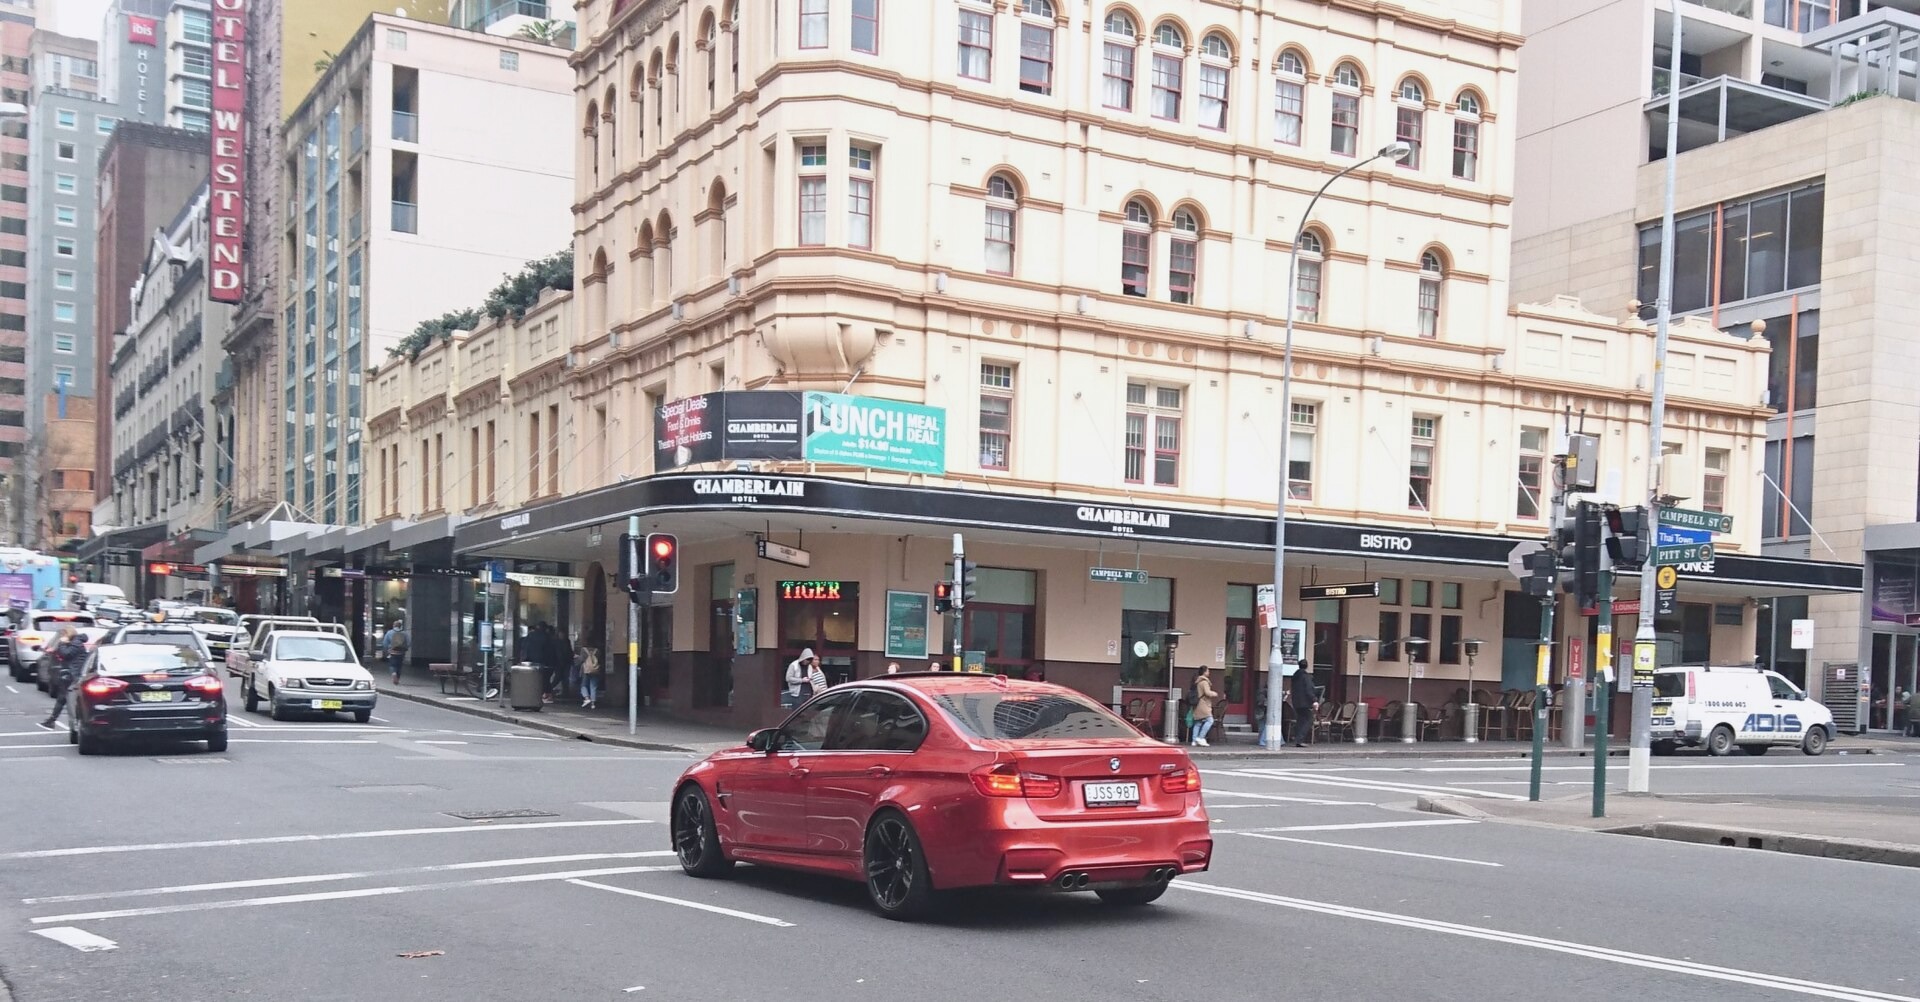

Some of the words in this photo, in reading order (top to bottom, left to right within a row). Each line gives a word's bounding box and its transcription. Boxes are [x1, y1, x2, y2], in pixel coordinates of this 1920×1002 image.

[132, 22, 153, 36] ibis
[138, 49, 148, 115] HOTEL
[214, 110, 240, 290] WESTEND
[661, 400, 685, 422] Special
[686, 395, 708, 413] Deals
[685, 416, 702, 428] Drinks
[728, 423, 798, 434] CHAMBERLAIN
[813, 402, 904, 441] LUNCH
[906, 413, 940, 431] MEAL
[690, 430, 713, 442] Holders
[693, 478, 805, 497] CHAMBERLAIN
[731, 495, 758, 503] HOTEL
[1076, 506, 1171, 528] CHAMBERLAIN
[1660, 510, 1705, 526] CAMPBELL
[1708, 518, 1720, 528] ST
[1112, 525, 1134, 533] HOTEL
[1360, 534, 1412, 551] BISTRO
[1658, 532, 1675, 542] Thai
[1675, 533, 1694, 545] Town
[1659, 550, 1681, 561] PITT
[1684, 549, 1697, 559] ST
[533, 576, 561, 587] CENTRAL
[1091, 570, 1122, 578] CAMPBELL
[782, 581, 841, 599] TIGER
[1325, 588, 1347, 596] BISTRO
[1573, 645, 1581, 669] VIP
[1651, 717, 1676, 726] DIS
[1740, 713, 1802, 732] ADIS
